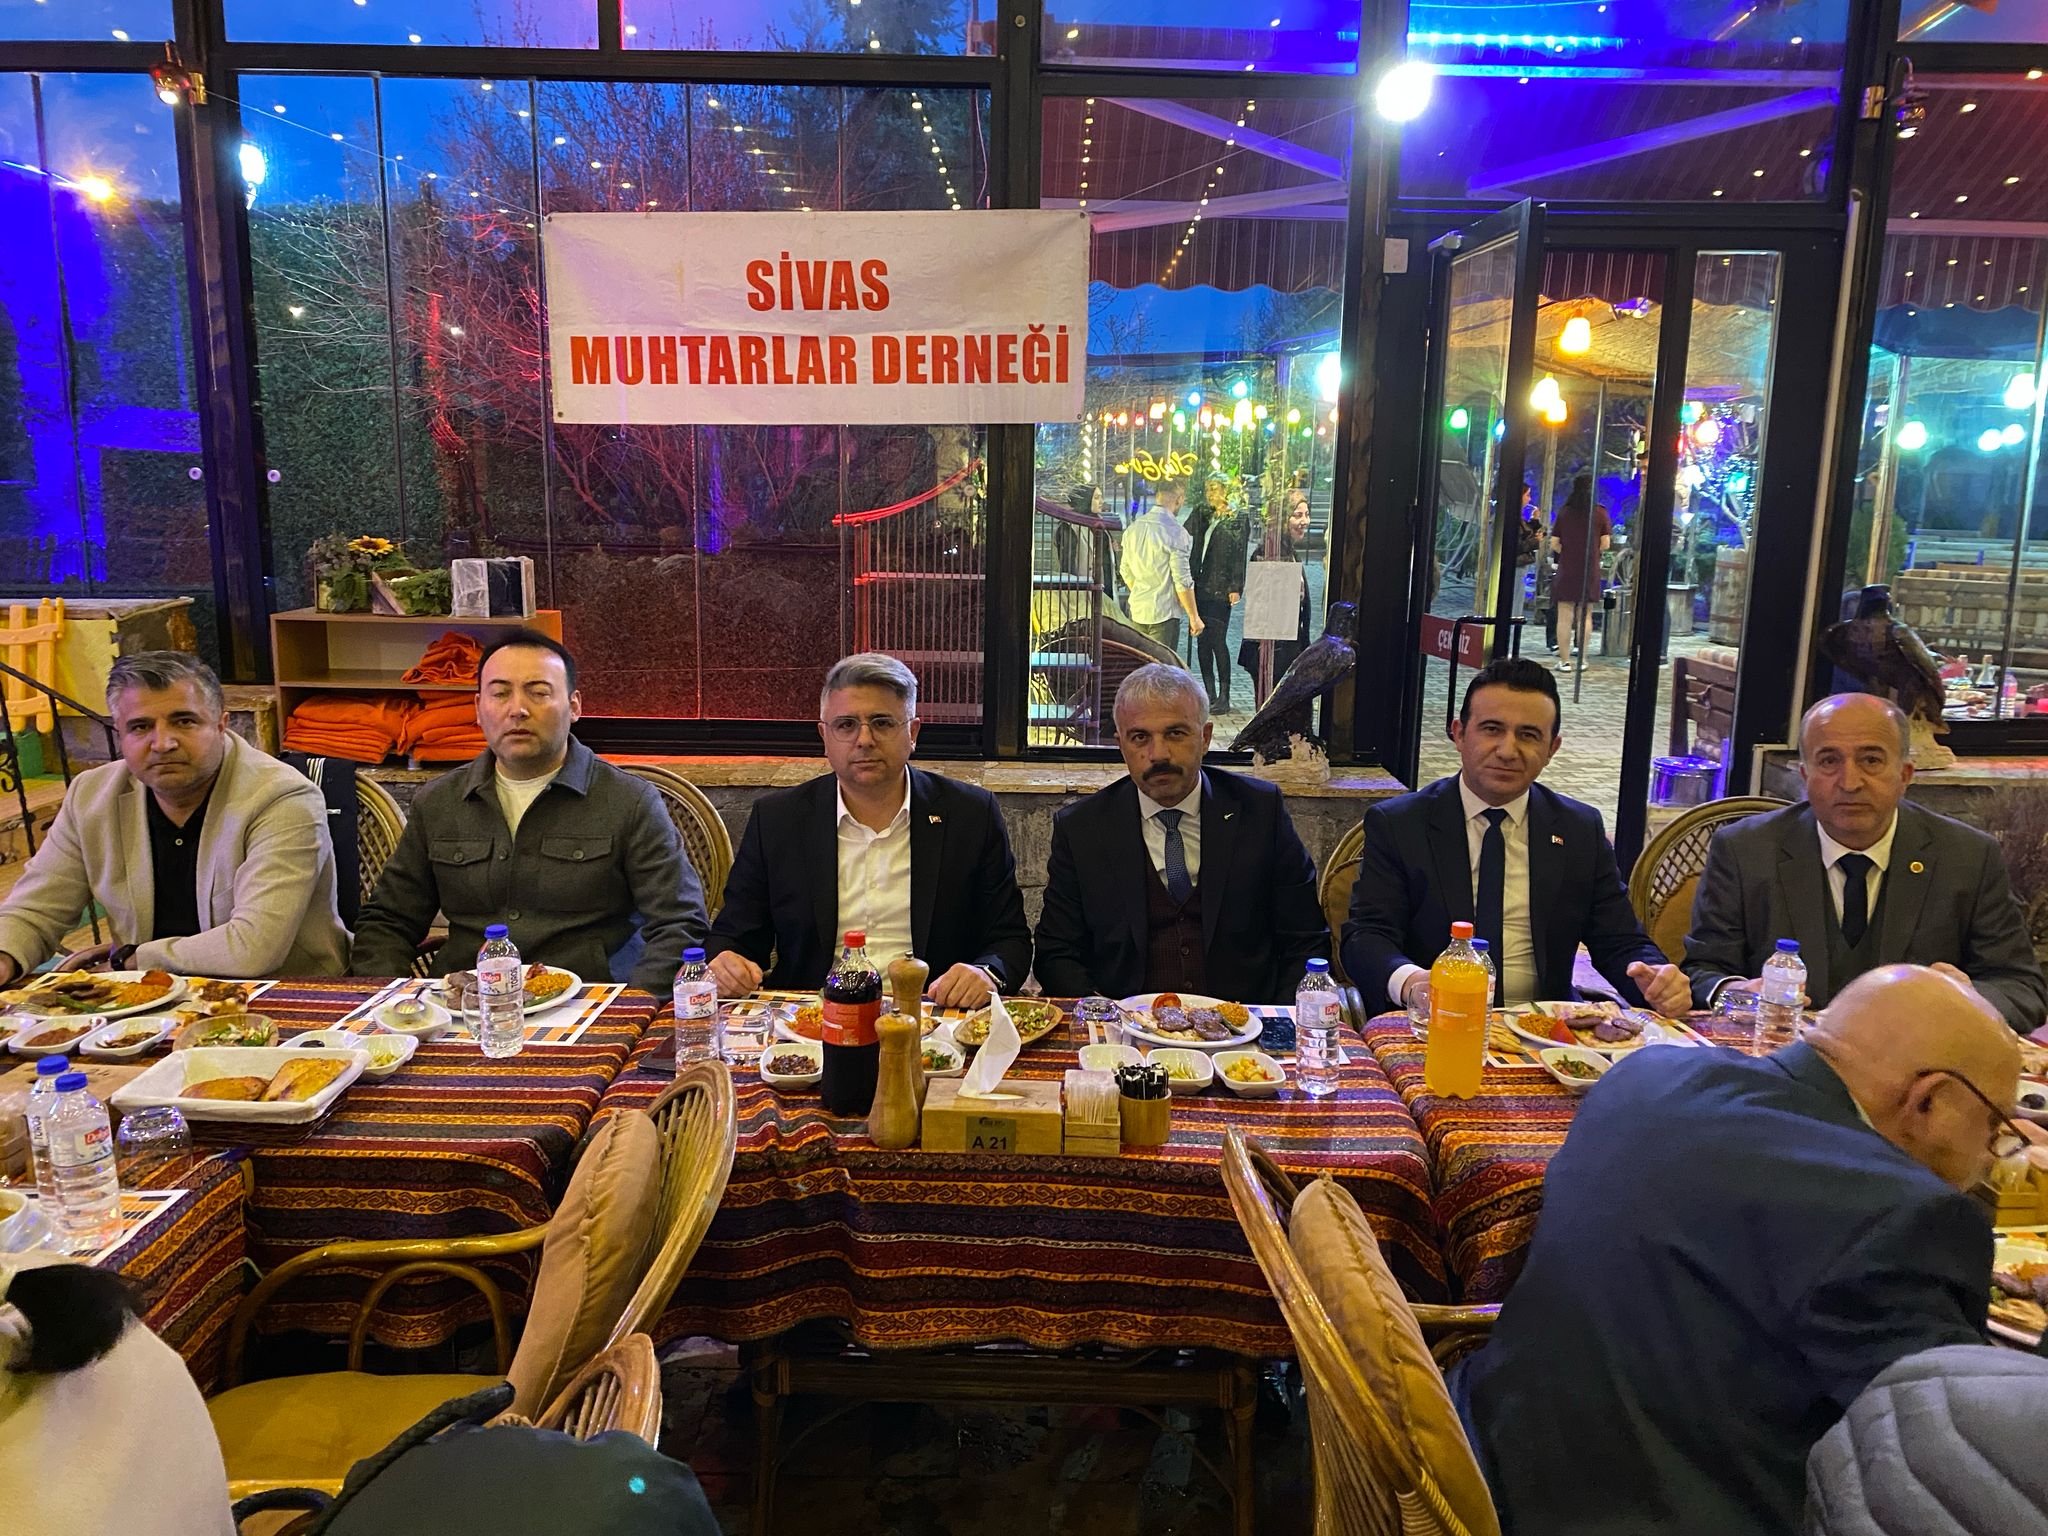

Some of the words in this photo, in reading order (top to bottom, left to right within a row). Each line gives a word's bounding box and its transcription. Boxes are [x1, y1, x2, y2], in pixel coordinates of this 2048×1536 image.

[746, 251, 890, 312] SİVAS
[570, 335, 858, 385] MUHTARLAR
[872, 323, 1069, 384] DERNEĞİ
[972, 1135, 985, 1149] A
[989, 1136, 1007, 1150] 21
